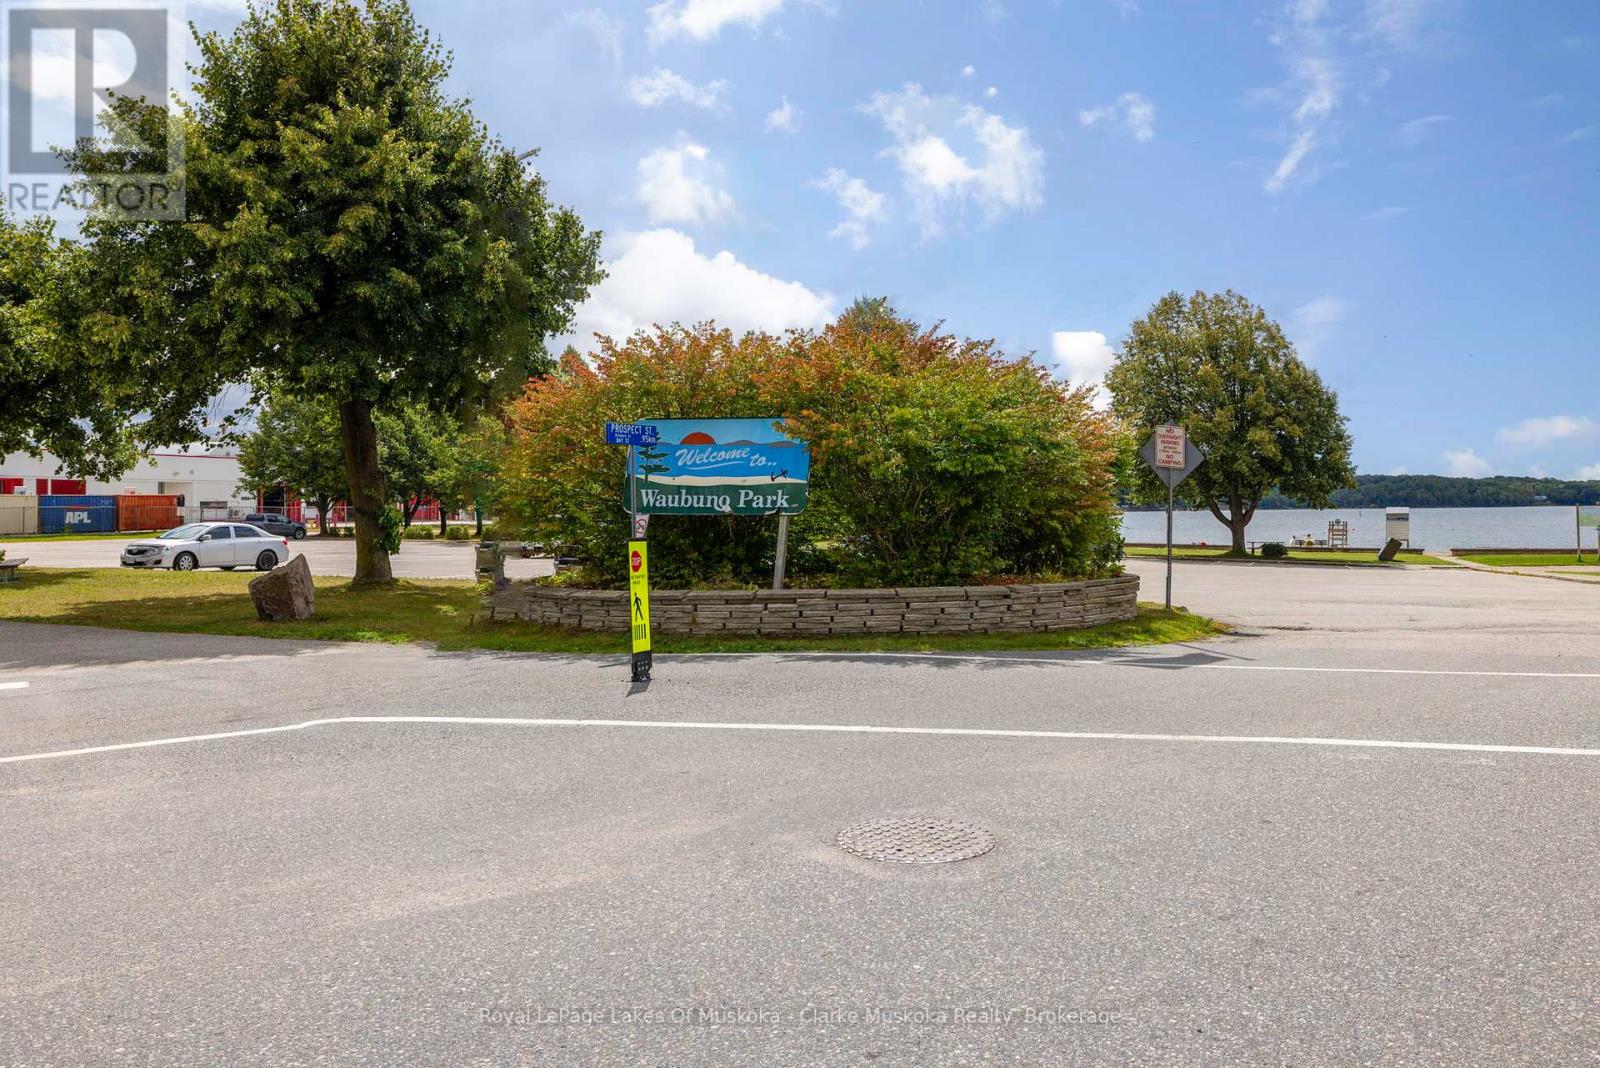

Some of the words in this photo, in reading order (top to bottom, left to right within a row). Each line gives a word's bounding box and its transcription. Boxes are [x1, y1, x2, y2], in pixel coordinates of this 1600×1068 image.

[610, 423, 642, 434] PROSPECT
[675, 447, 750, 467] Welcome
[737, 489, 789, 508] Park
[65, 511, 91, 524] APL
